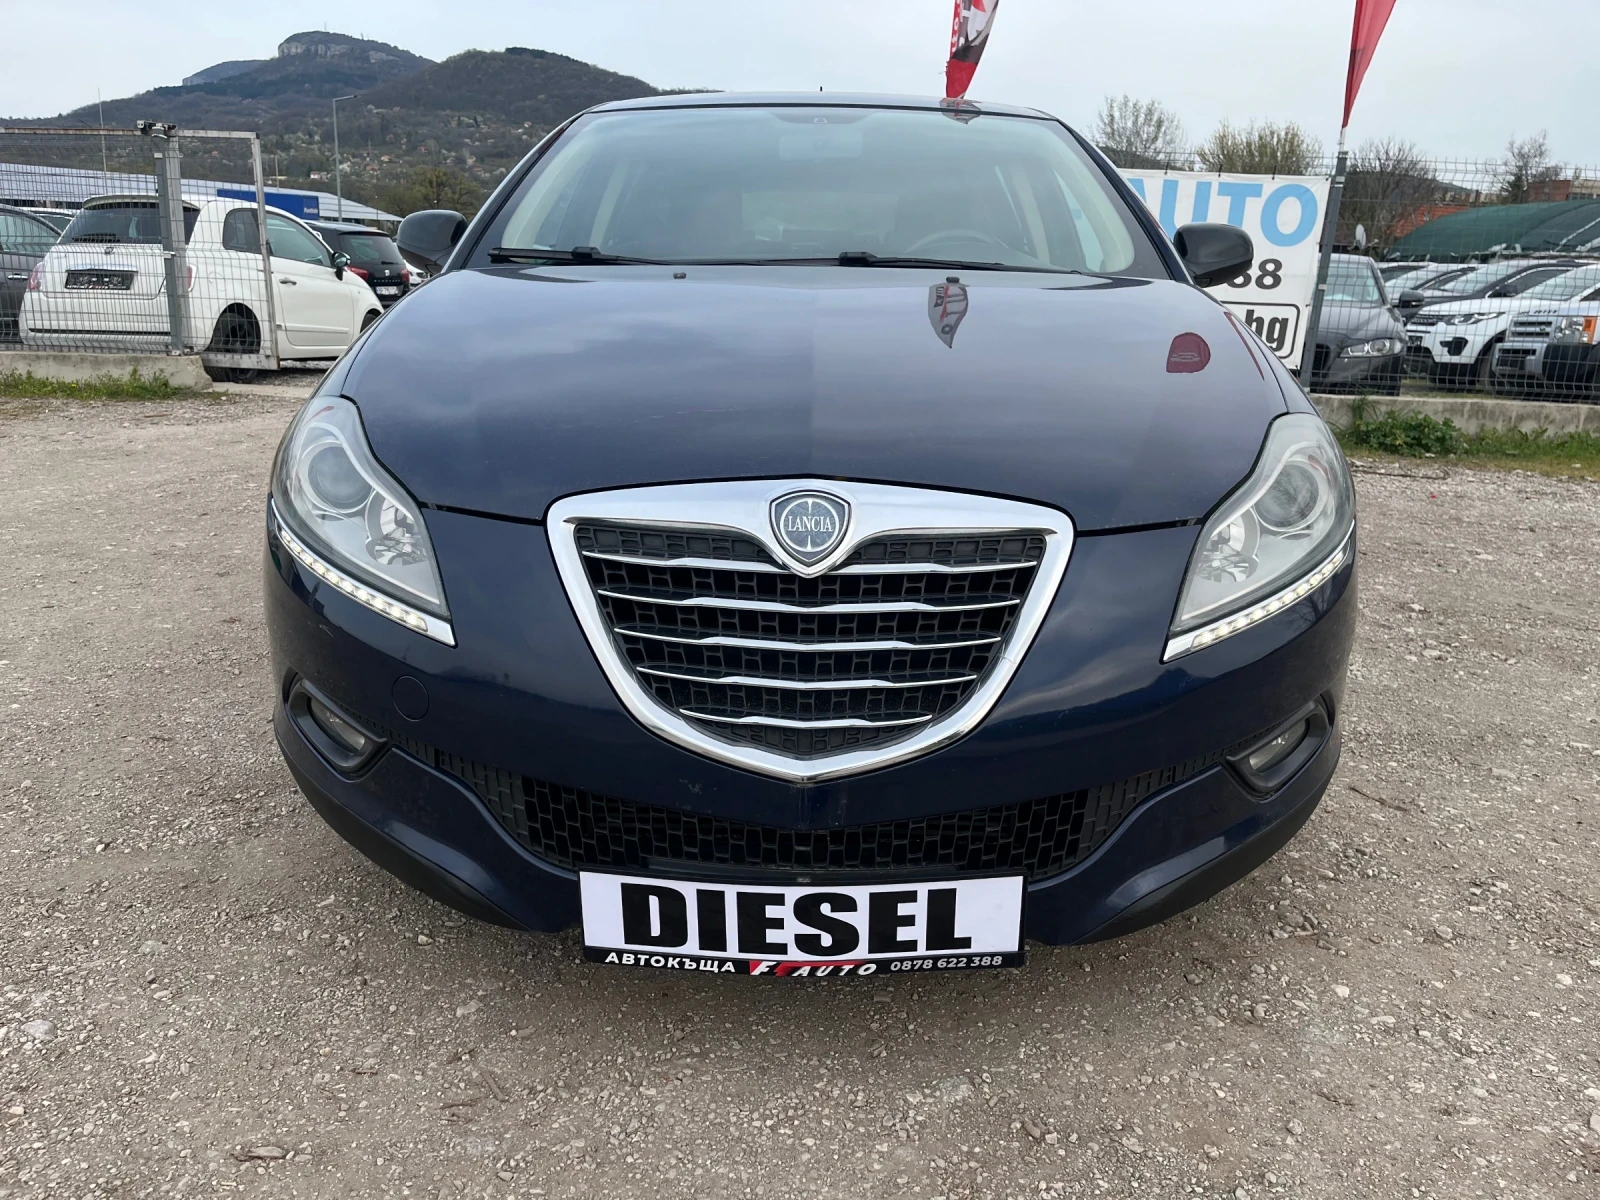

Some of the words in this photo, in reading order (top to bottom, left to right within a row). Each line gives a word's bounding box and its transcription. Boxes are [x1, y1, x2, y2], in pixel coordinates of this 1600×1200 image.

[788, 516, 834, 532] LANCIA
[620, 882, 972, 956] DIESEL
[604, 951, 736, 973] АВТОКЪЩА
[791, 963, 877, 978] AUTO
[890, 958, 933, 972] 0878
[937, 957, 967, 970] 622
[970, 955, 1003, 967] 388
